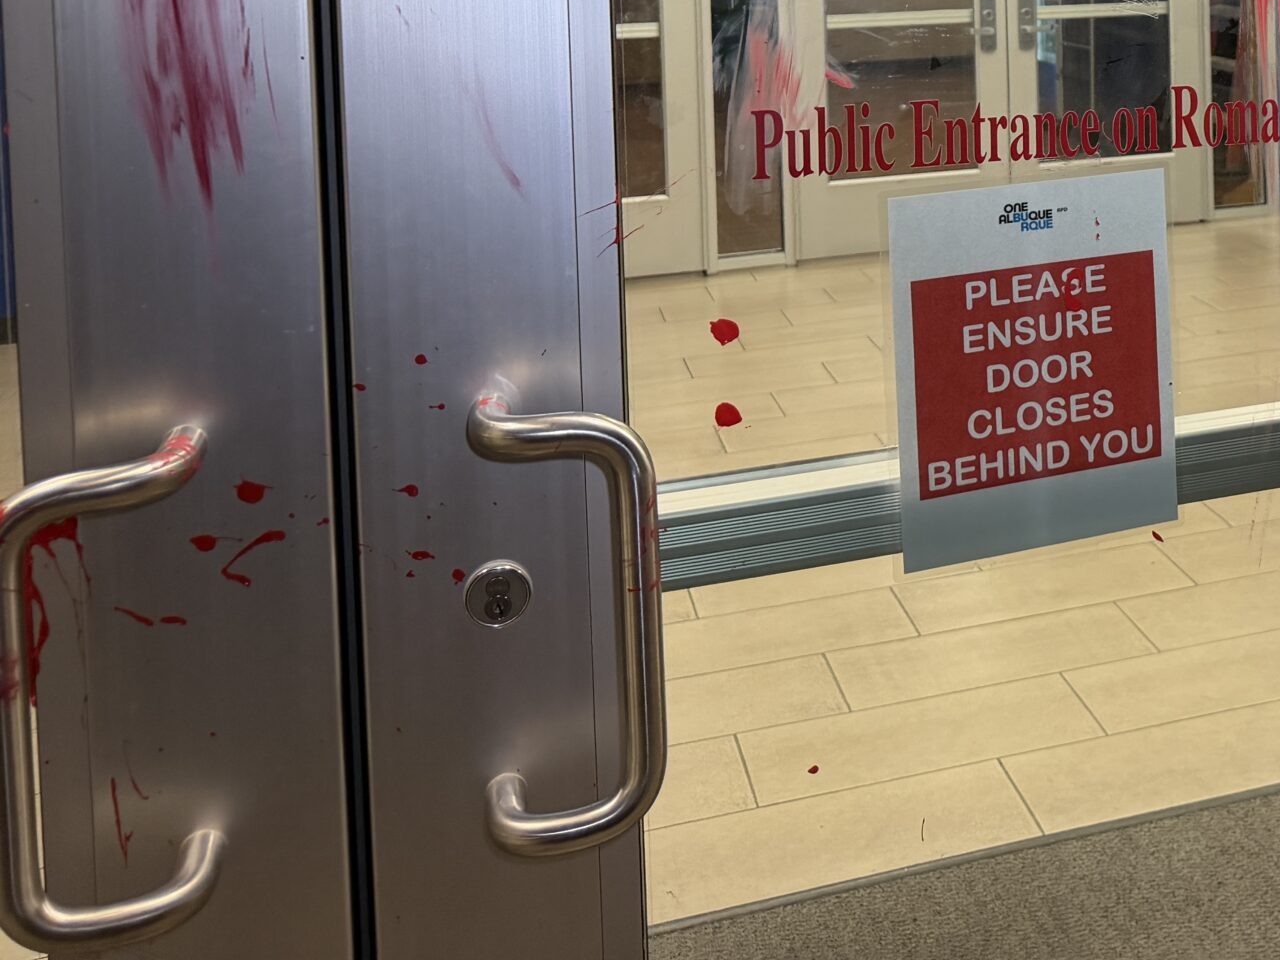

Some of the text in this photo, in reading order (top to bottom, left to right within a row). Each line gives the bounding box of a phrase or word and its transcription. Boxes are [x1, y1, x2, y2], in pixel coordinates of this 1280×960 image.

[751, 102, 897, 181] Public
[910, 99, 1101, 170] Entrance
[1112, 102, 1160, 155] on
[1003, 202, 1028, 214] ONE
[962, 305, 1113, 354] ENSURE
[986, 350, 1094, 393] DOOR
[967, 389, 1115, 440] CLOSES
[927, 424, 1154, 491] BEHIND YOU
